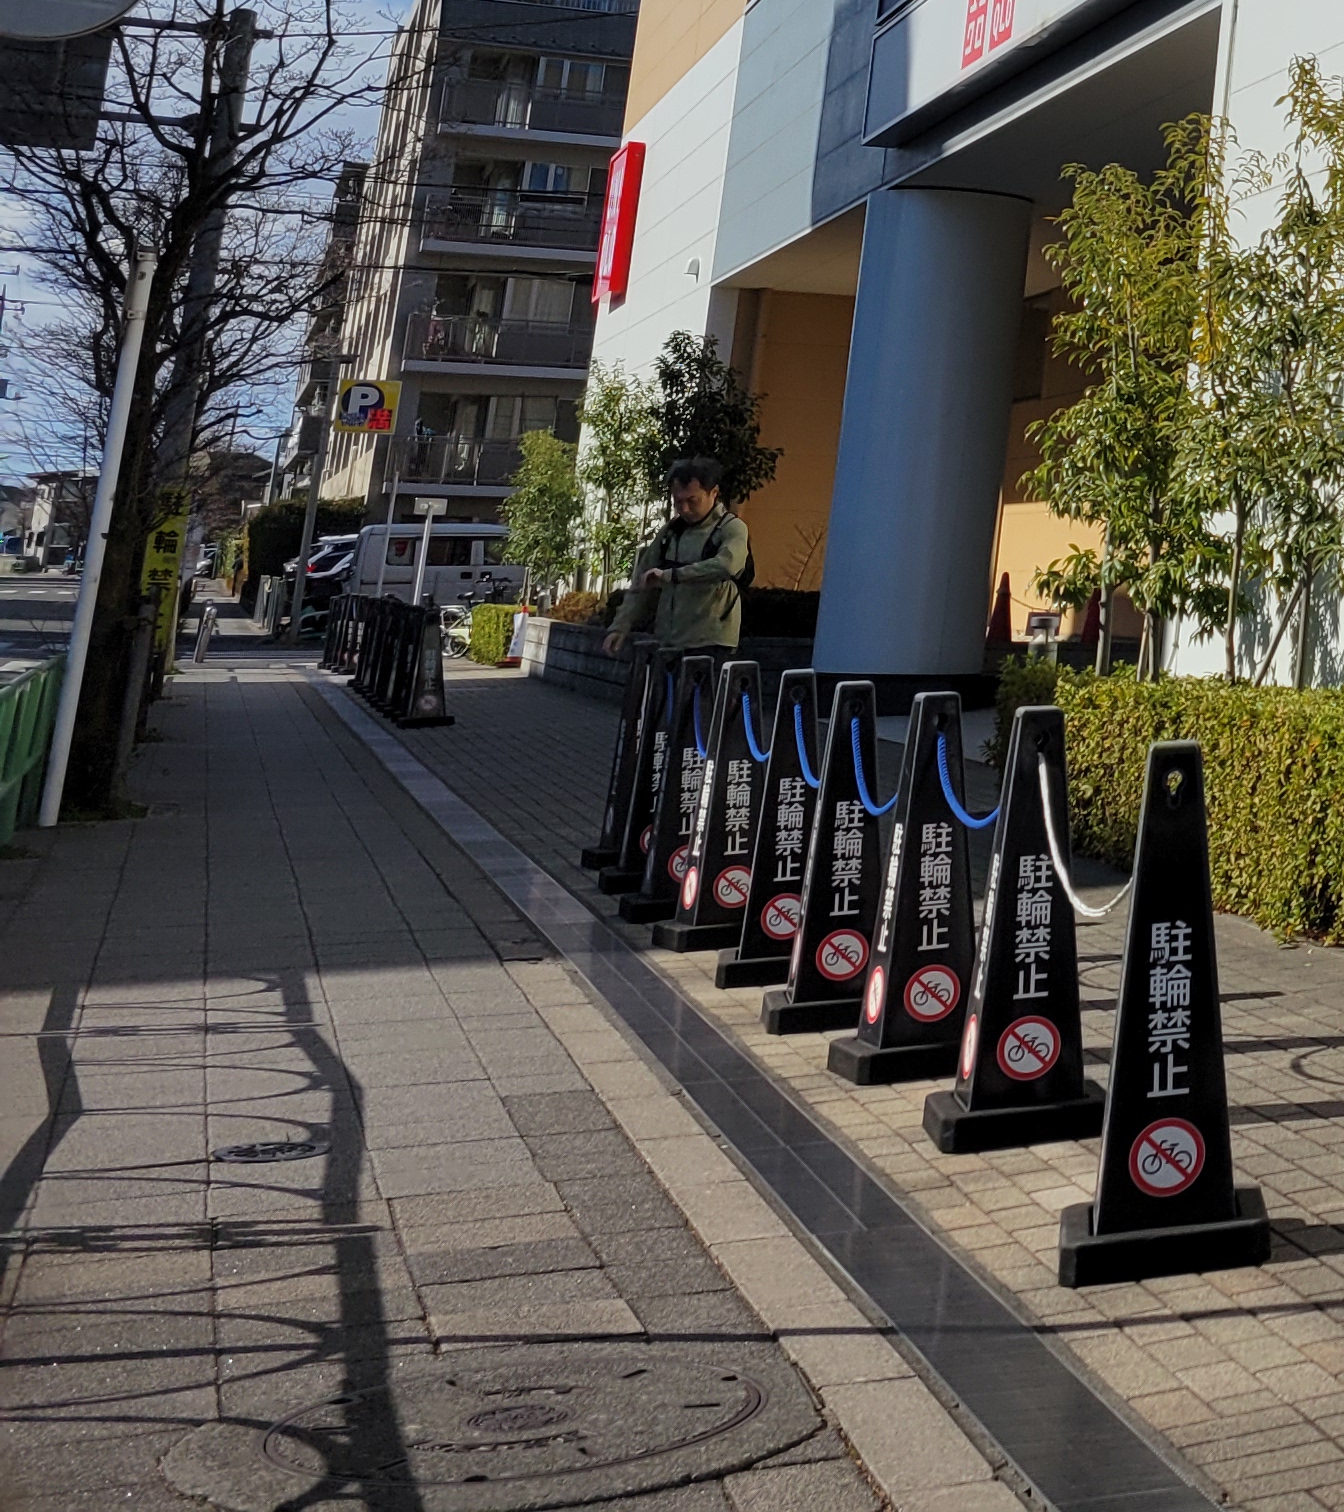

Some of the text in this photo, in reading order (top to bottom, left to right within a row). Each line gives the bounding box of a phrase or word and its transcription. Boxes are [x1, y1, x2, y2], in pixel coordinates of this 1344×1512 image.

[348, 386, 380, 413] P
[723, 759, 752, 856] 駐輪禁止
[773, 776, 806, 883] 駐輪禁止
[829, 800, 865, 918] 駐輪禁止
[917, 822, 953, 952] 駐輪禁止
[1013, 853, 1054, 1001] 駐輪禁止
[1147, 920, 1193, 1099] 駐輪禁止
